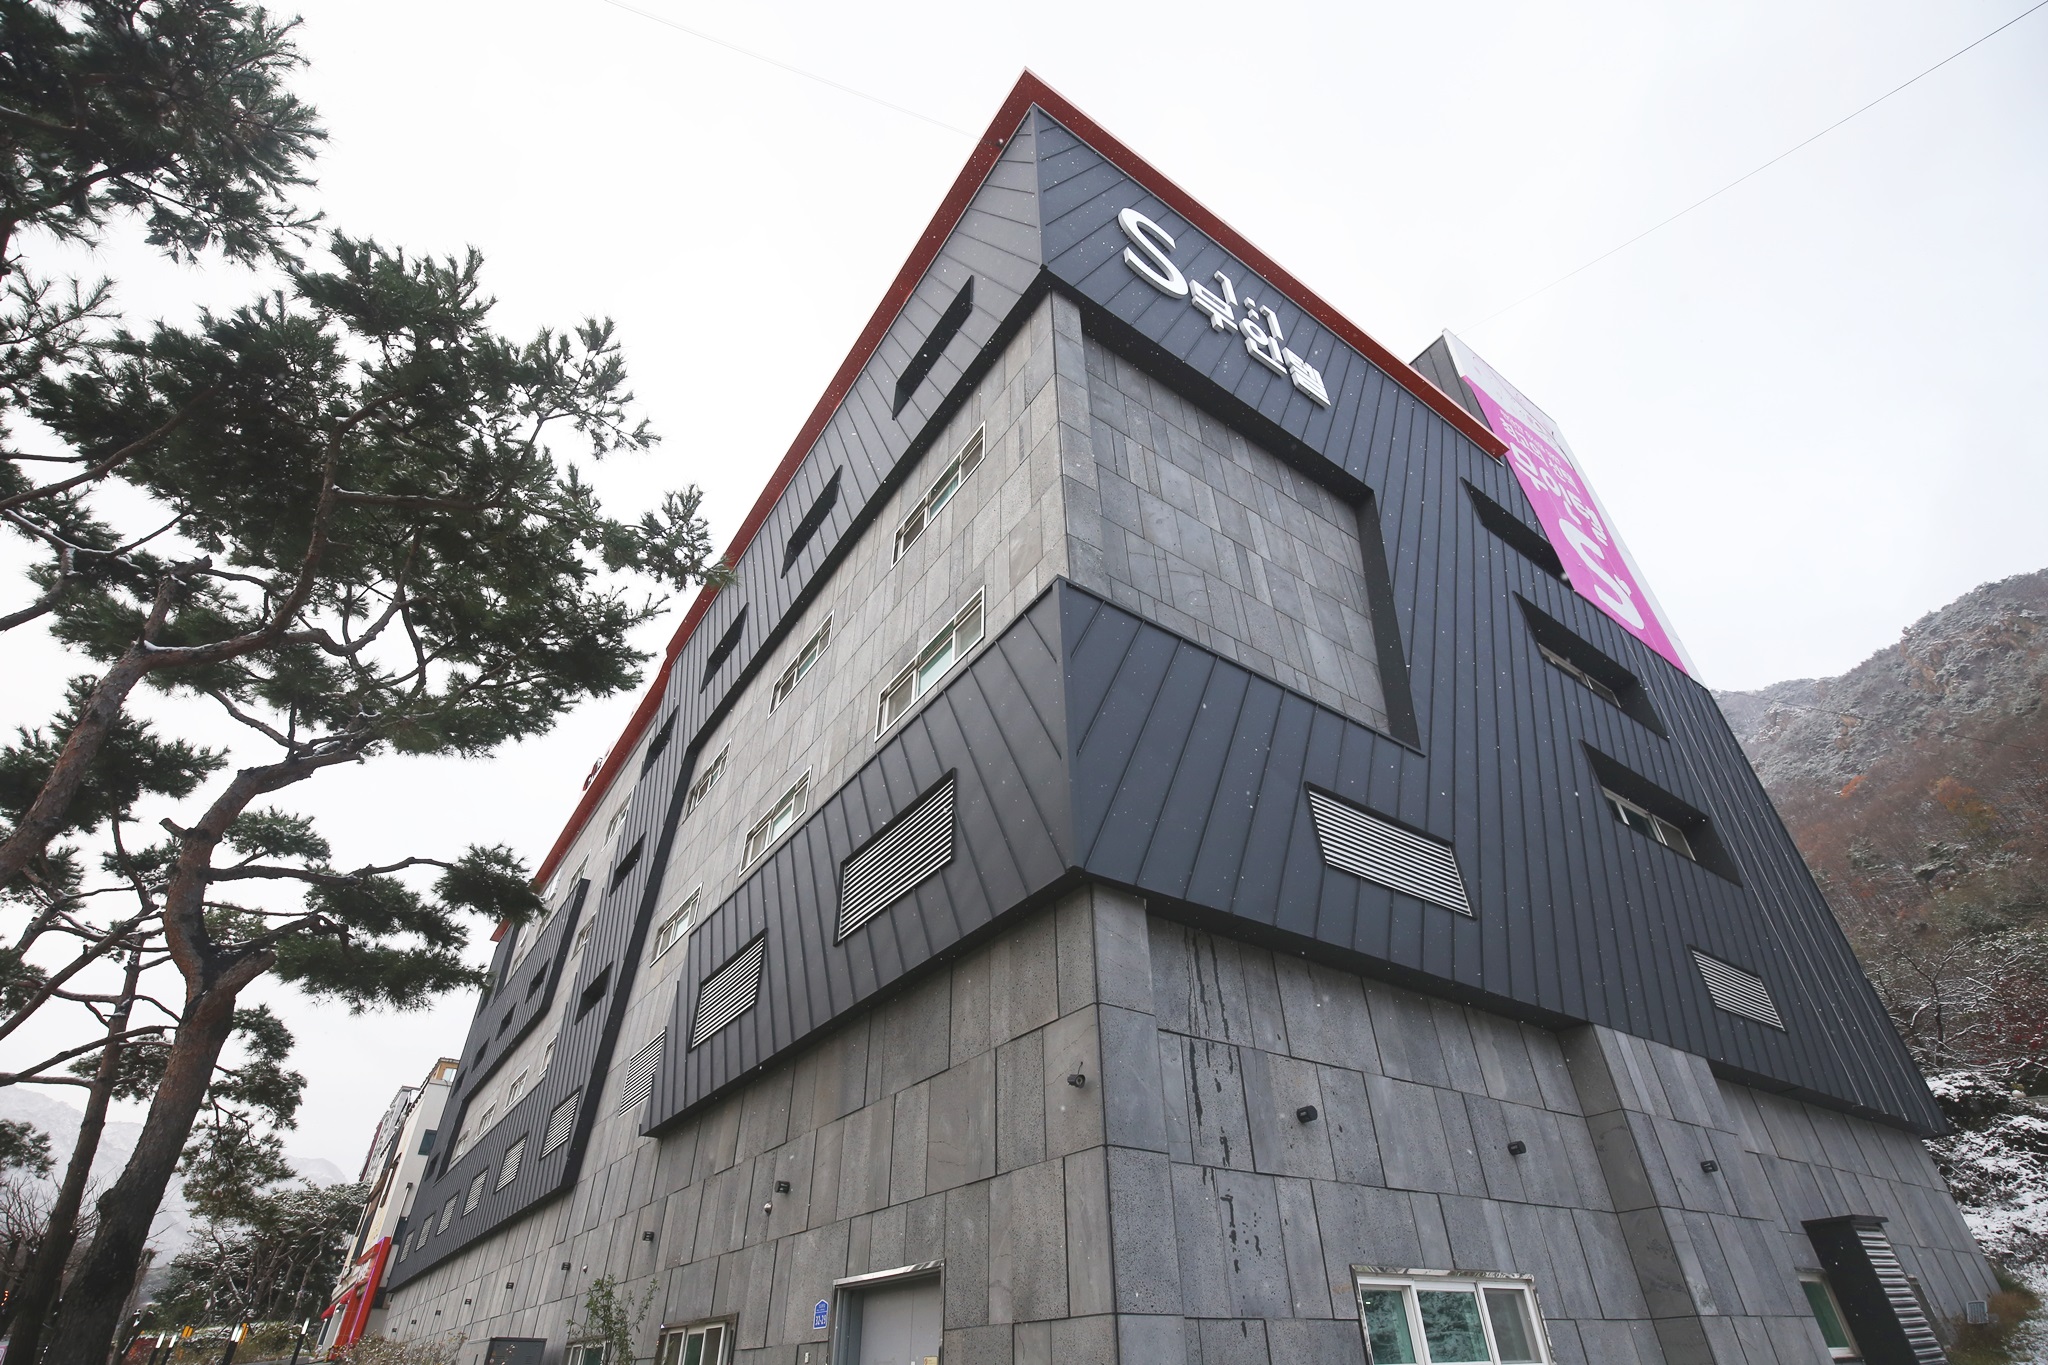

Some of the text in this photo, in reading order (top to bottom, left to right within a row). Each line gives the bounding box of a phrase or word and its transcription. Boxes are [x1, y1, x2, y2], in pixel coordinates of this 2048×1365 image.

[1499, 416, 1550, 468] 최고의
[1547, 458, 1581, 494] 선택
[1510, 441, 1609, 546] 무인텔
[1559, 517, 1646, 630] S
